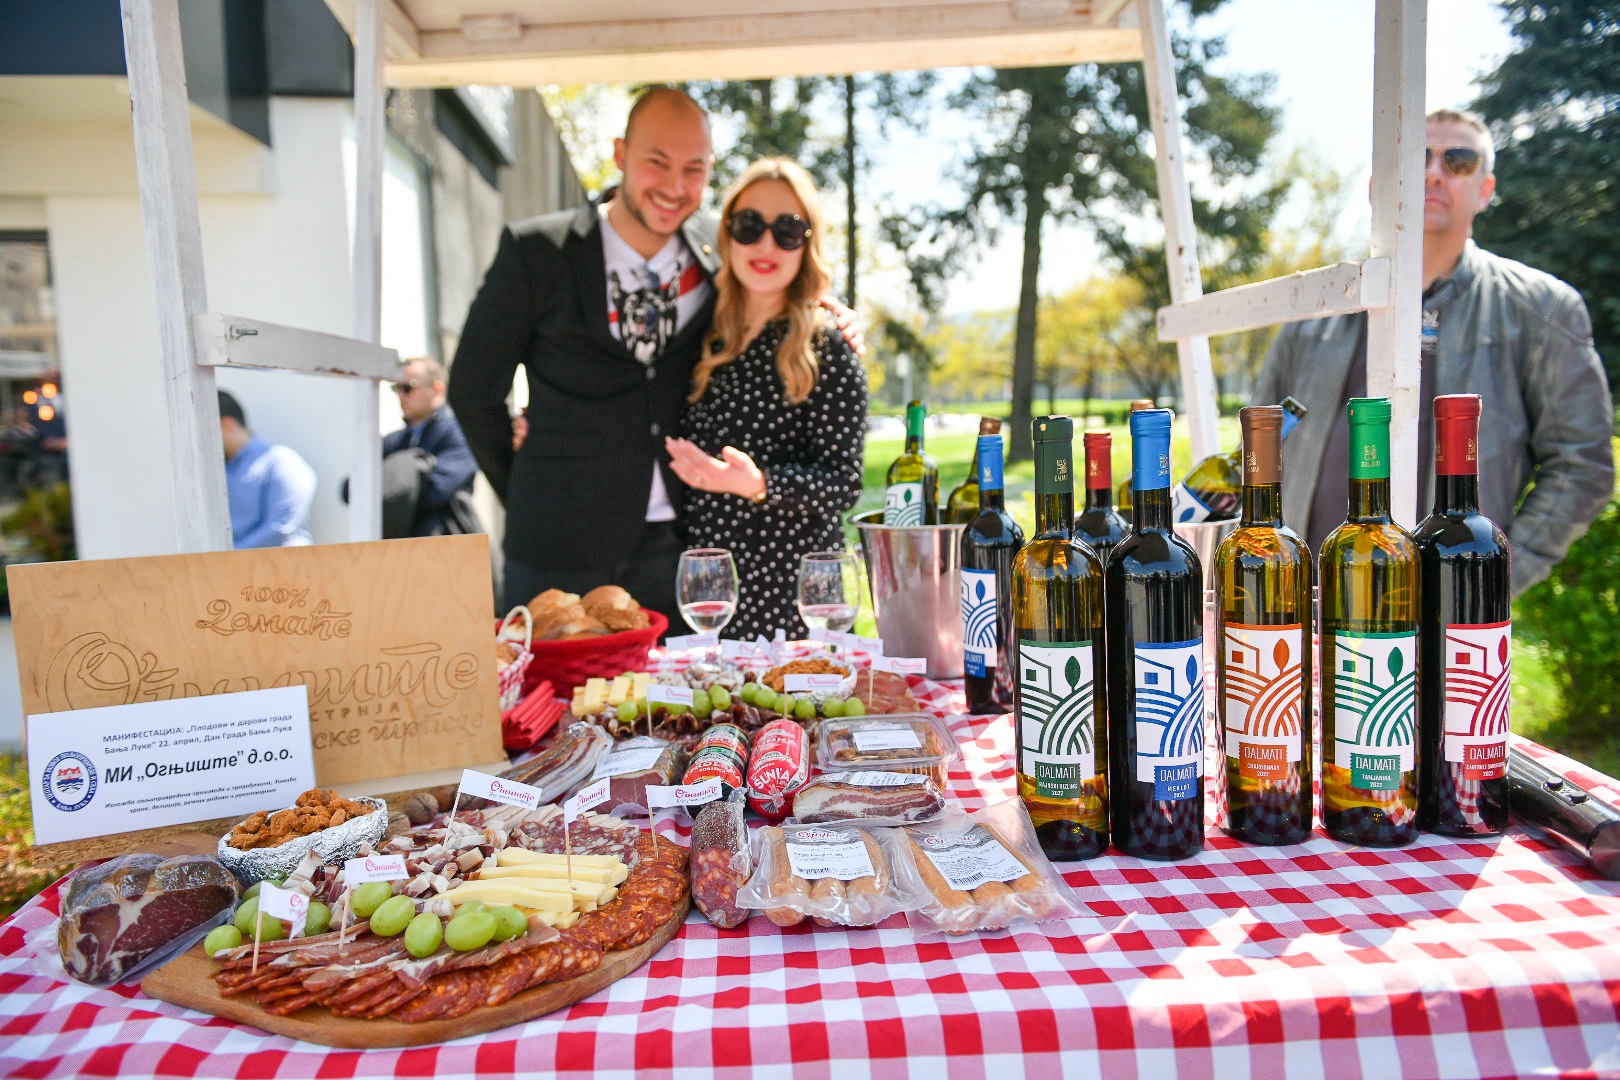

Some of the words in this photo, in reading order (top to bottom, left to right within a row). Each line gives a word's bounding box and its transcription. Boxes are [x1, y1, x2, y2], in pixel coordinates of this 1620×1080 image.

[240, 585, 310, 608] 100%
[310, 702, 400, 722] СТРИЈА
[103, 726, 184, 742] МАНИФЕСТАЦИЈА:
[237, 718, 267, 727] дарови
[270, 714, 292, 724] града
[104, 746, 128, 754] Бања
[158, 740, 170, 748] 22.
[173, 736, 202, 746] април,
[204, 734, 220, 743] Дан
[222, 730, 246, 741] Града
[248, 728, 270, 736] Бања
[272, 726, 292, 734] Лука
[313, 728, 360, 750] ске
[1244, 746, 1283, 760] DALMATI
[1470, 746, 1504, 760] DALMATI
[104, 766, 133, 784] МИ
[248, 748, 293, 764] д.о.о.
[1040, 765, 1076, 779] DALMATI
[1356, 756, 1396, 771] DALMATI
[1160, 766, 1194, 782] DALMATI
